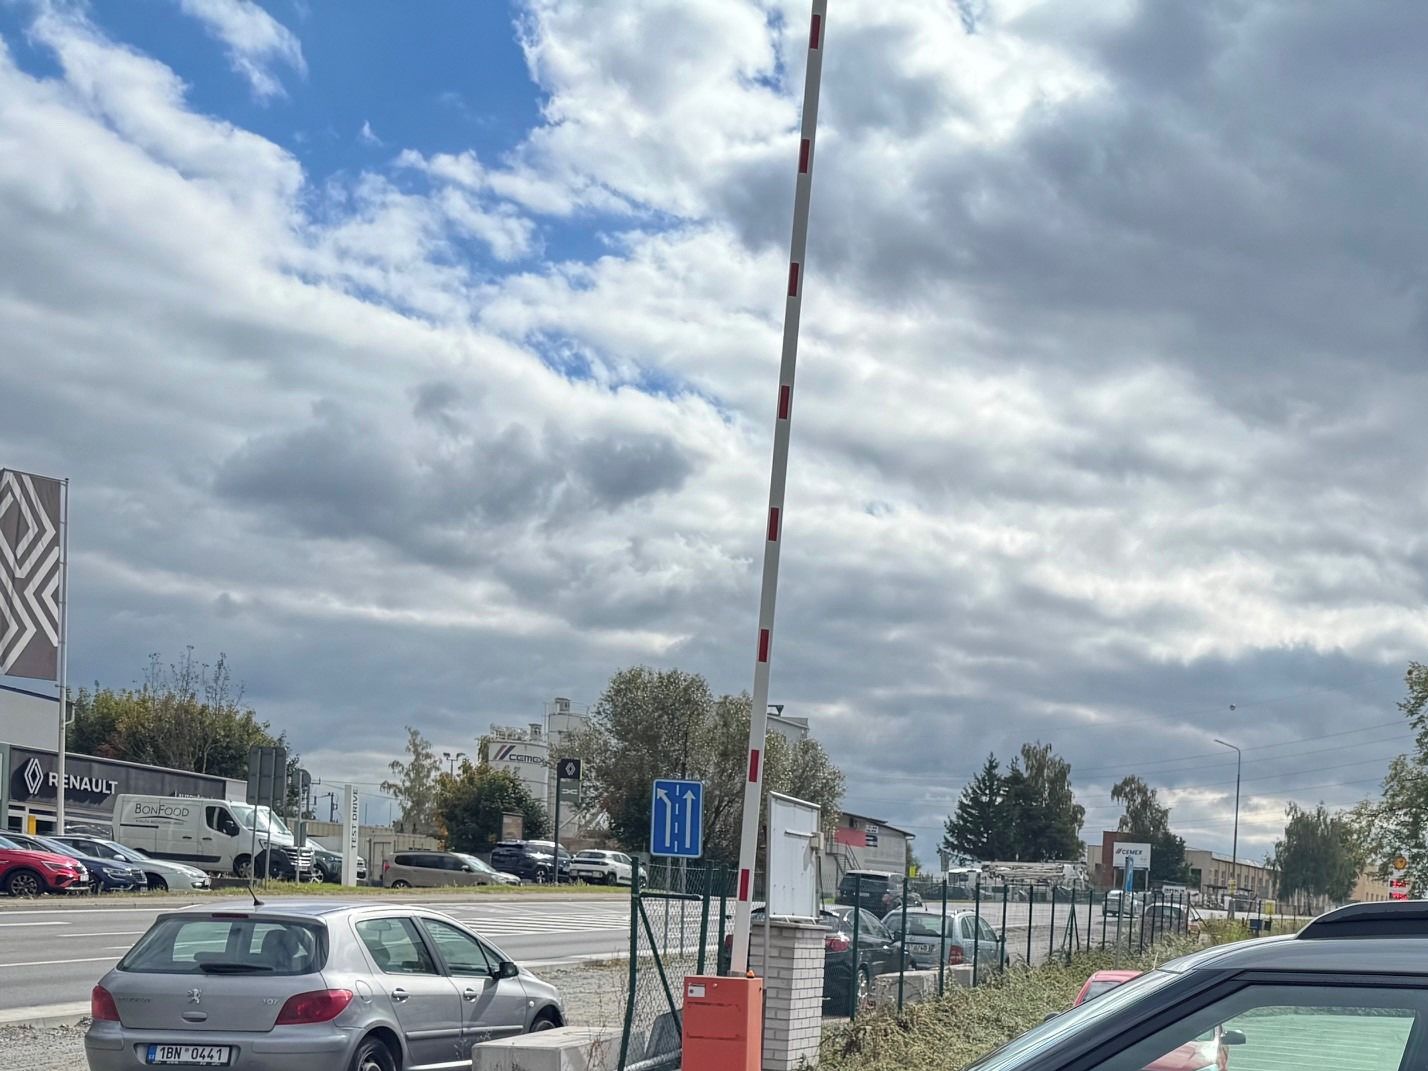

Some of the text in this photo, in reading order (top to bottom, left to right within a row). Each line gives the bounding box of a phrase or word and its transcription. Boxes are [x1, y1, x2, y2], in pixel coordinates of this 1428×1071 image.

[48, 771, 119, 795] RENAULT
[160, 1046, 182, 1060] 1BN
[191, 1047, 222, 1061] 0441
